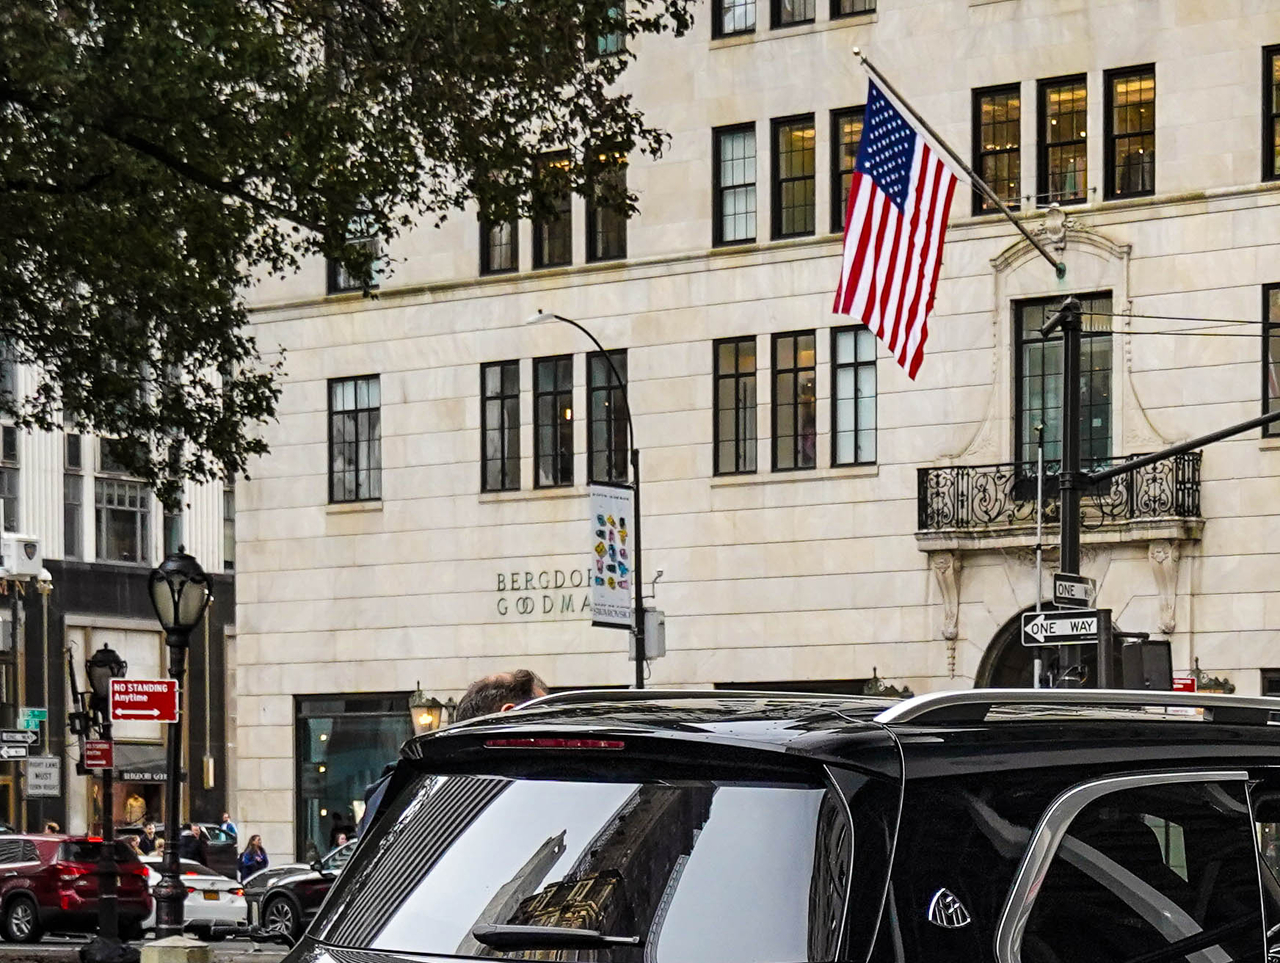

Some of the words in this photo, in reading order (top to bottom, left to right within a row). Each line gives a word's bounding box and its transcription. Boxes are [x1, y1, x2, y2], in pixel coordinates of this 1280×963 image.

[496, 568, 593, 592] BERGDO
[1057, 583, 1076, 597] ONE
[496, 593, 592, 616] GOODMA
[1031, 622, 1057, 635] ONE
[1069, 620, 1094, 633] WAY
[113, 683, 126, 692] NO
[127, 683, 168, 693] STANDING
[114, 693, 148, 703] Anytime
